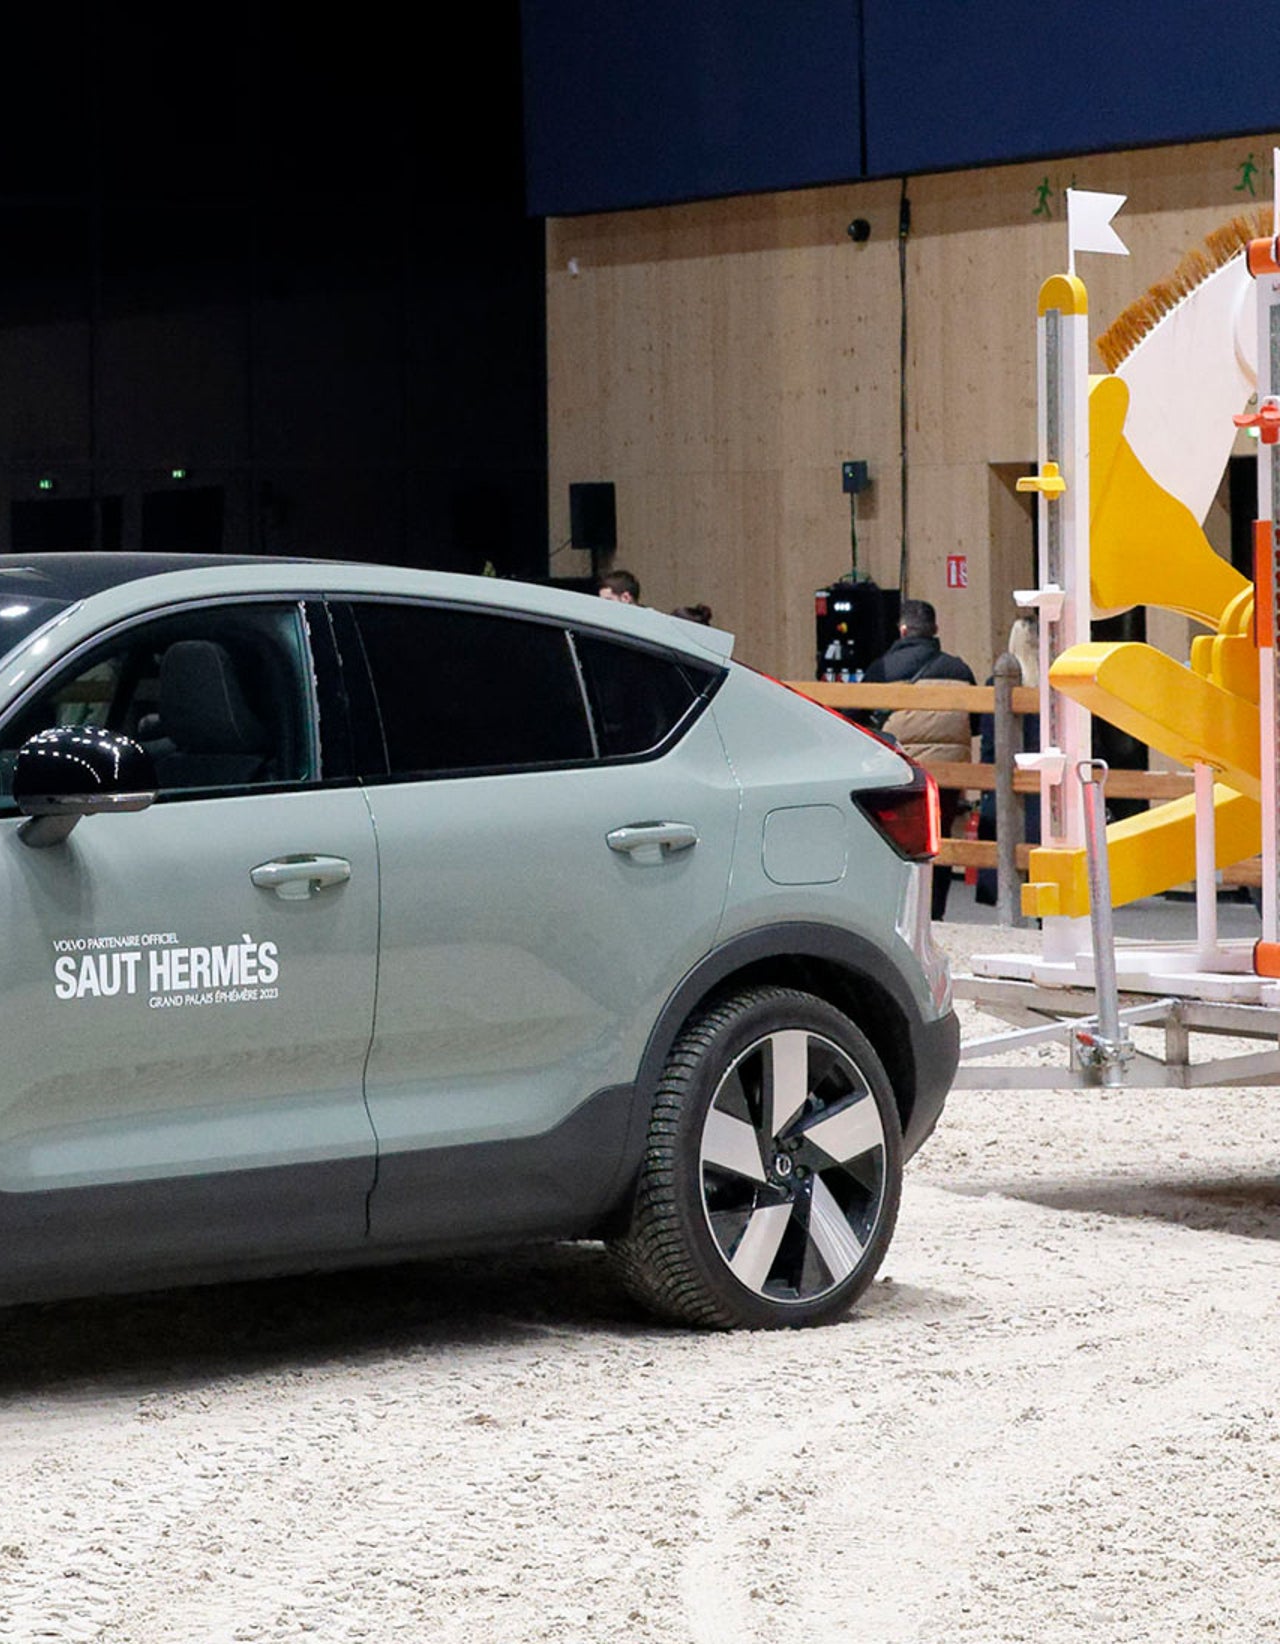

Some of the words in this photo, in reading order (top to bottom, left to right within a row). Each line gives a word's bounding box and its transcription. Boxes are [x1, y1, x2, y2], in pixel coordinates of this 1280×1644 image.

[53, 938, 86, 952] VOLVO
[87, 934, 140, 950] PARTENAIRE
[141, 932, 179, 946] OFFICIEL
[54, 951, 142, 999] SAUT
[149, 933, 279, 992] HERMÈS
[149, 995, 183, 1009] GRAND
[184, 991, 214, 1006] PALAIS
[259, 987, 279, 1000] 2023
